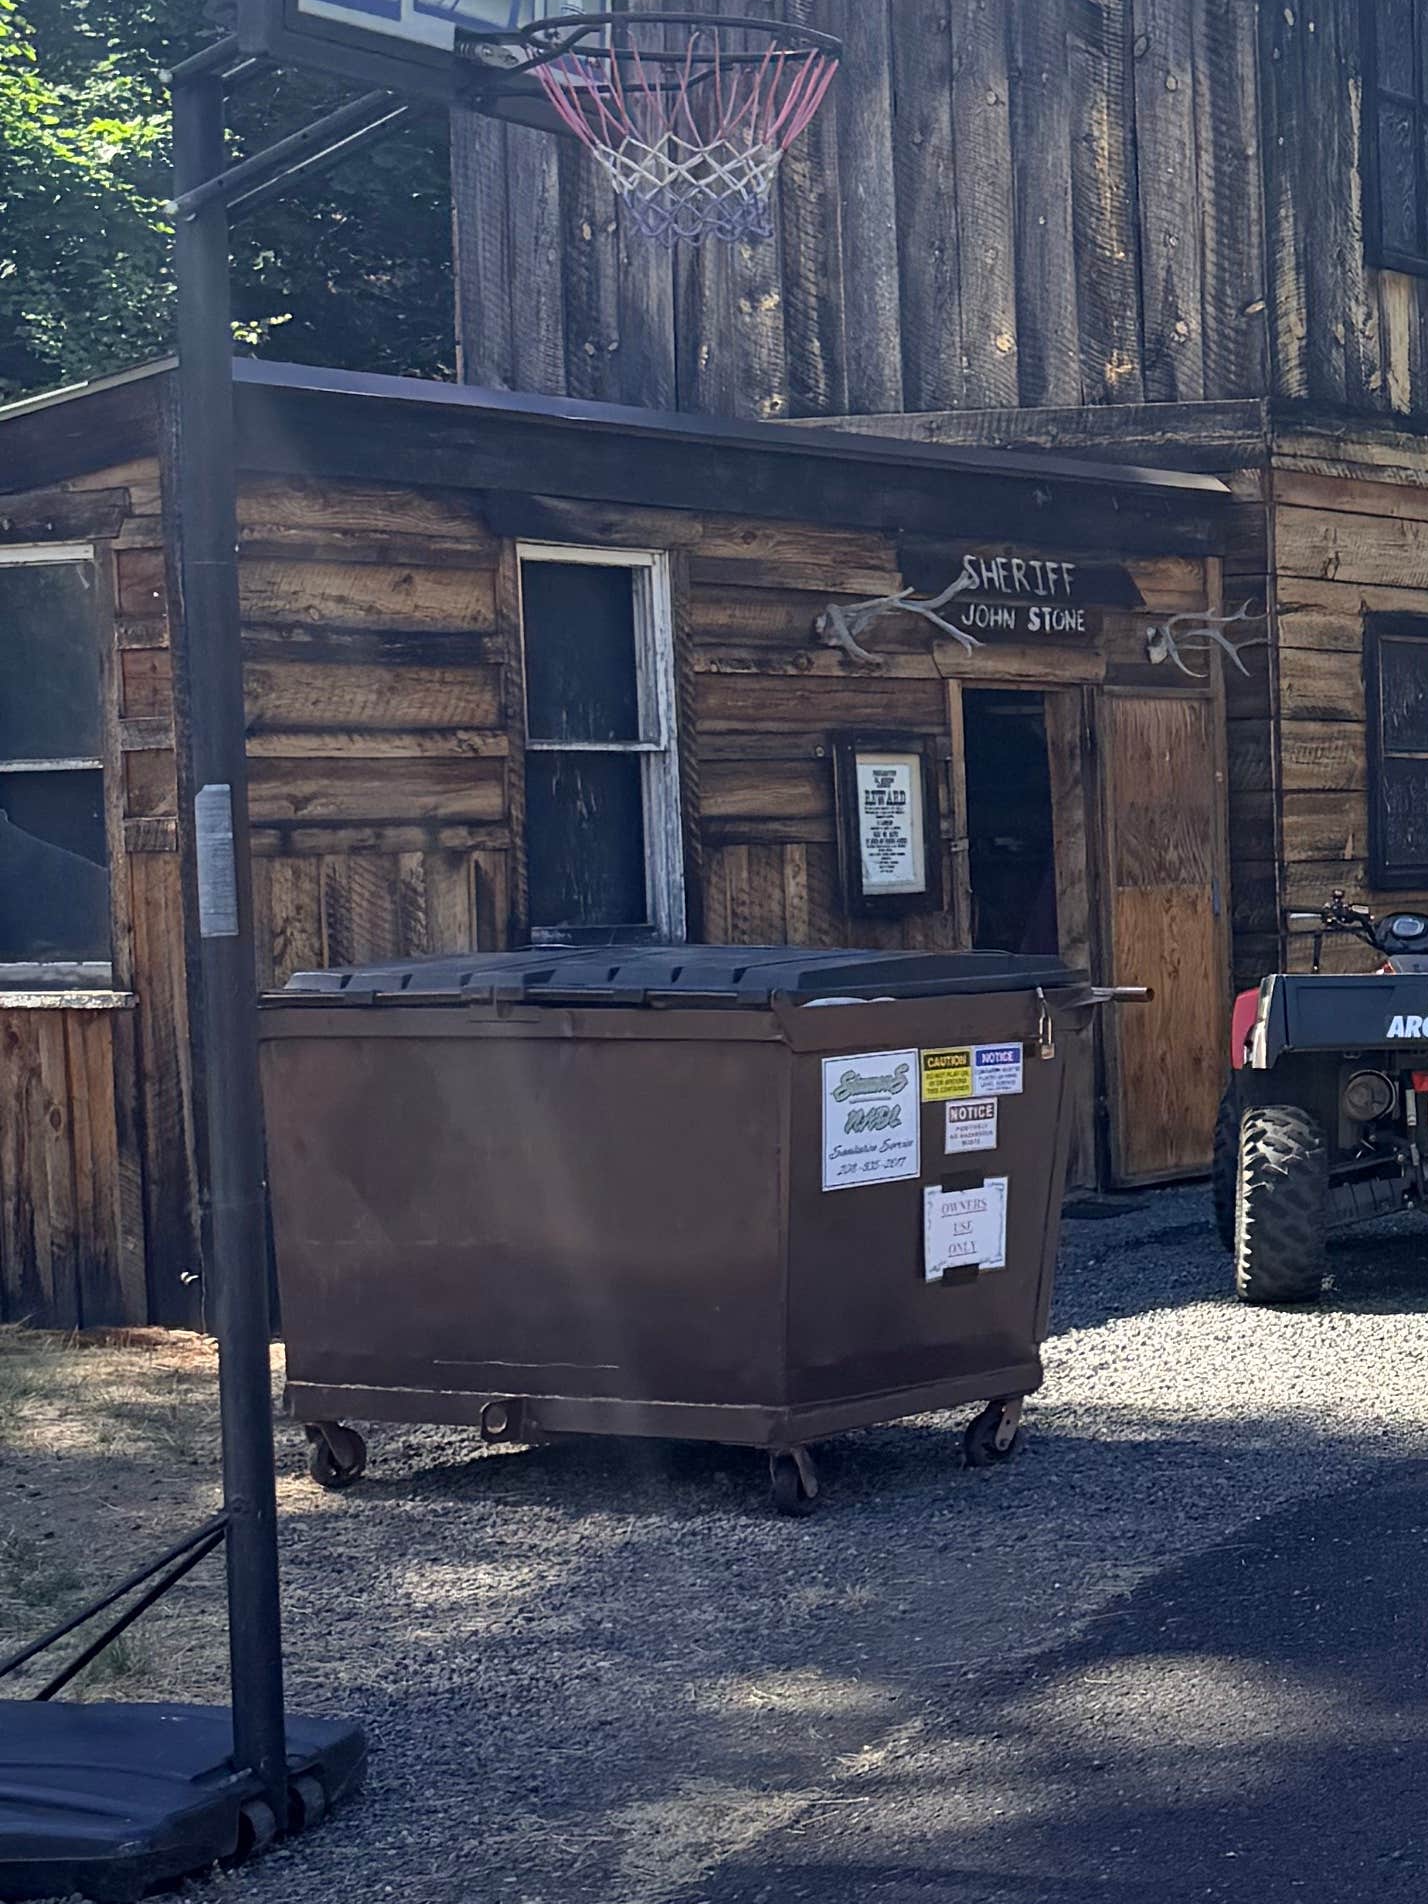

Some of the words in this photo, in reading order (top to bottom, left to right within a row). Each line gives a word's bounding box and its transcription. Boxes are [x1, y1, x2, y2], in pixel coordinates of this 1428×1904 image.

[963, 554, 1076, 596] SHERIFF
[961, 604, 1015, 629] JOHN
[1027, 606, 1086, 633] STONE
[927, 1054, 967, 1068] CAUTION
[981, 1051, 1013, 1064] NOTICE
[951, 1105, 993, 1121] NOTICE
